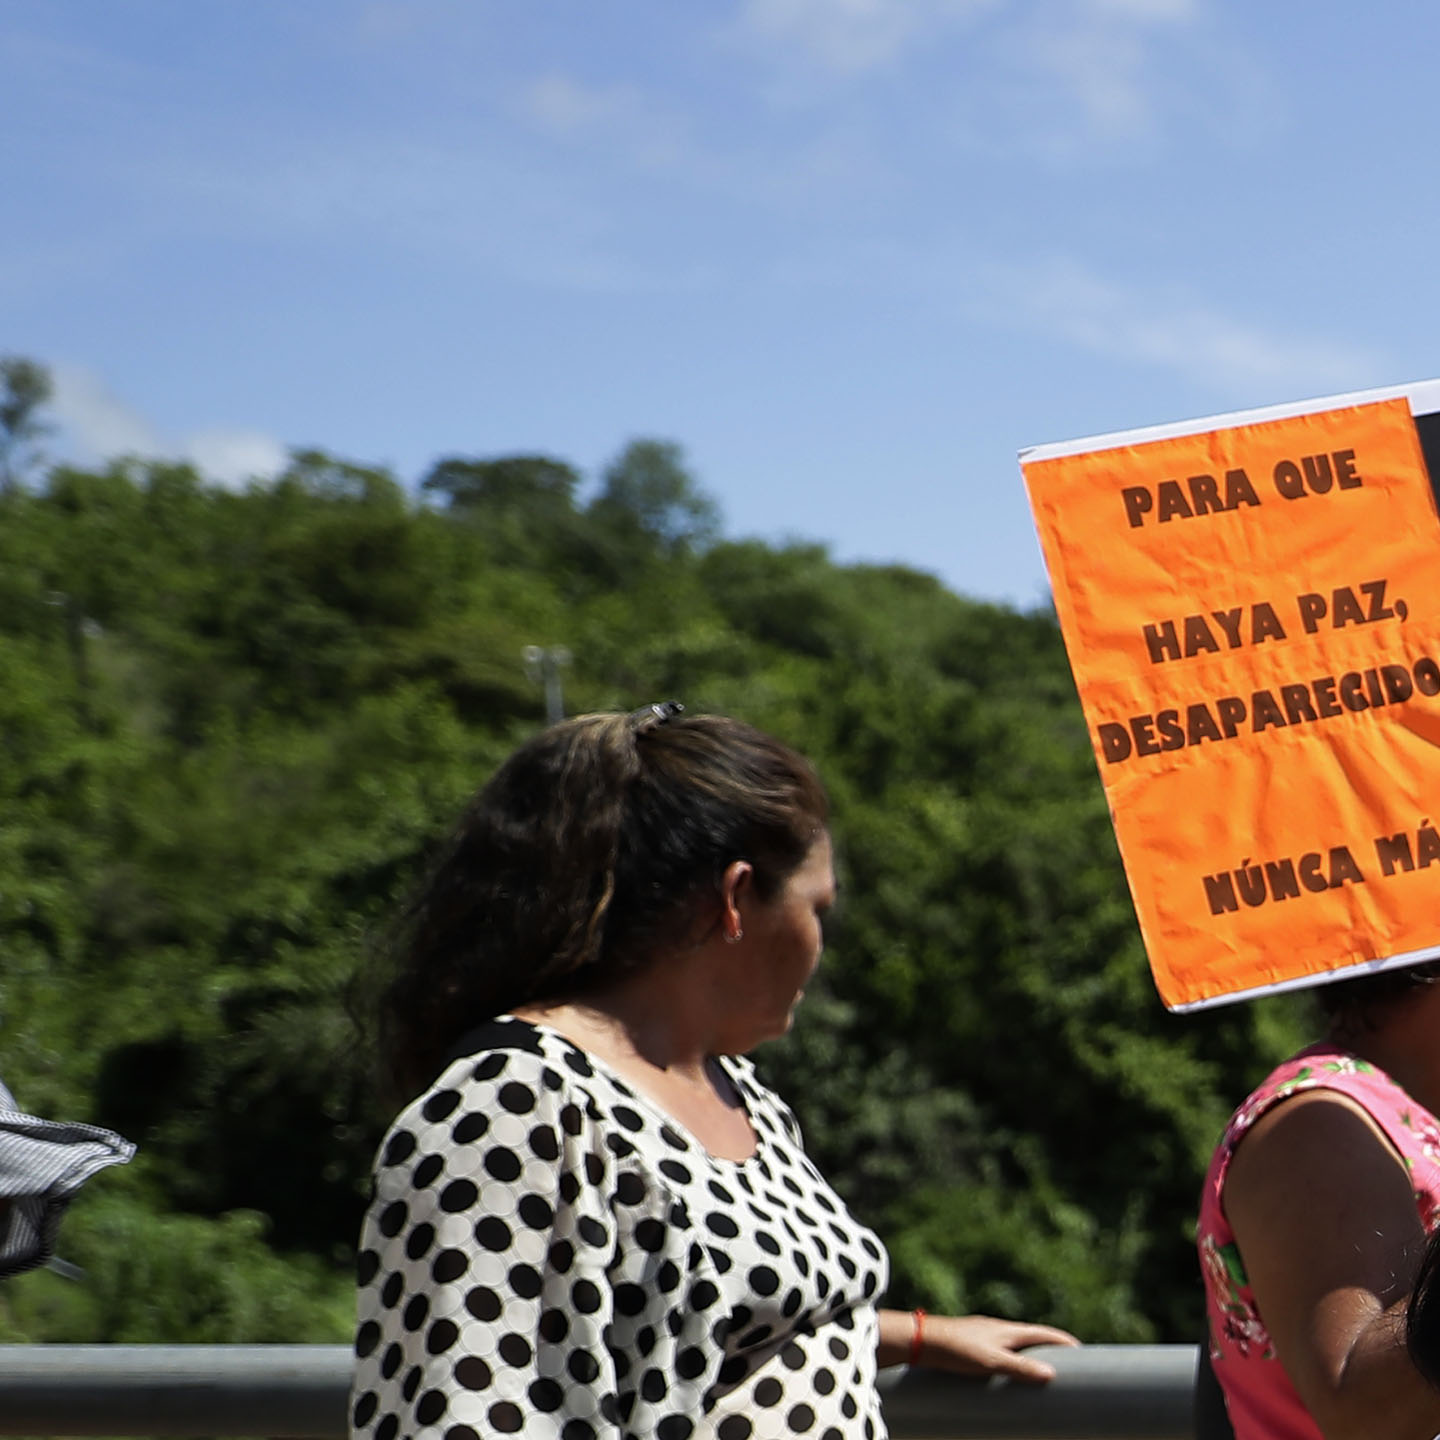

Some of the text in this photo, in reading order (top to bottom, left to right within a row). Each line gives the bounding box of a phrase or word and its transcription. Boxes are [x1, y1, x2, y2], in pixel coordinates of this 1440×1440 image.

[1120, 448, 1364, 529] PARA QUE
[1142, 578, 1409, 665] HAYA PAZ,
[1201, 845, 1365, 916] NÚNCA
